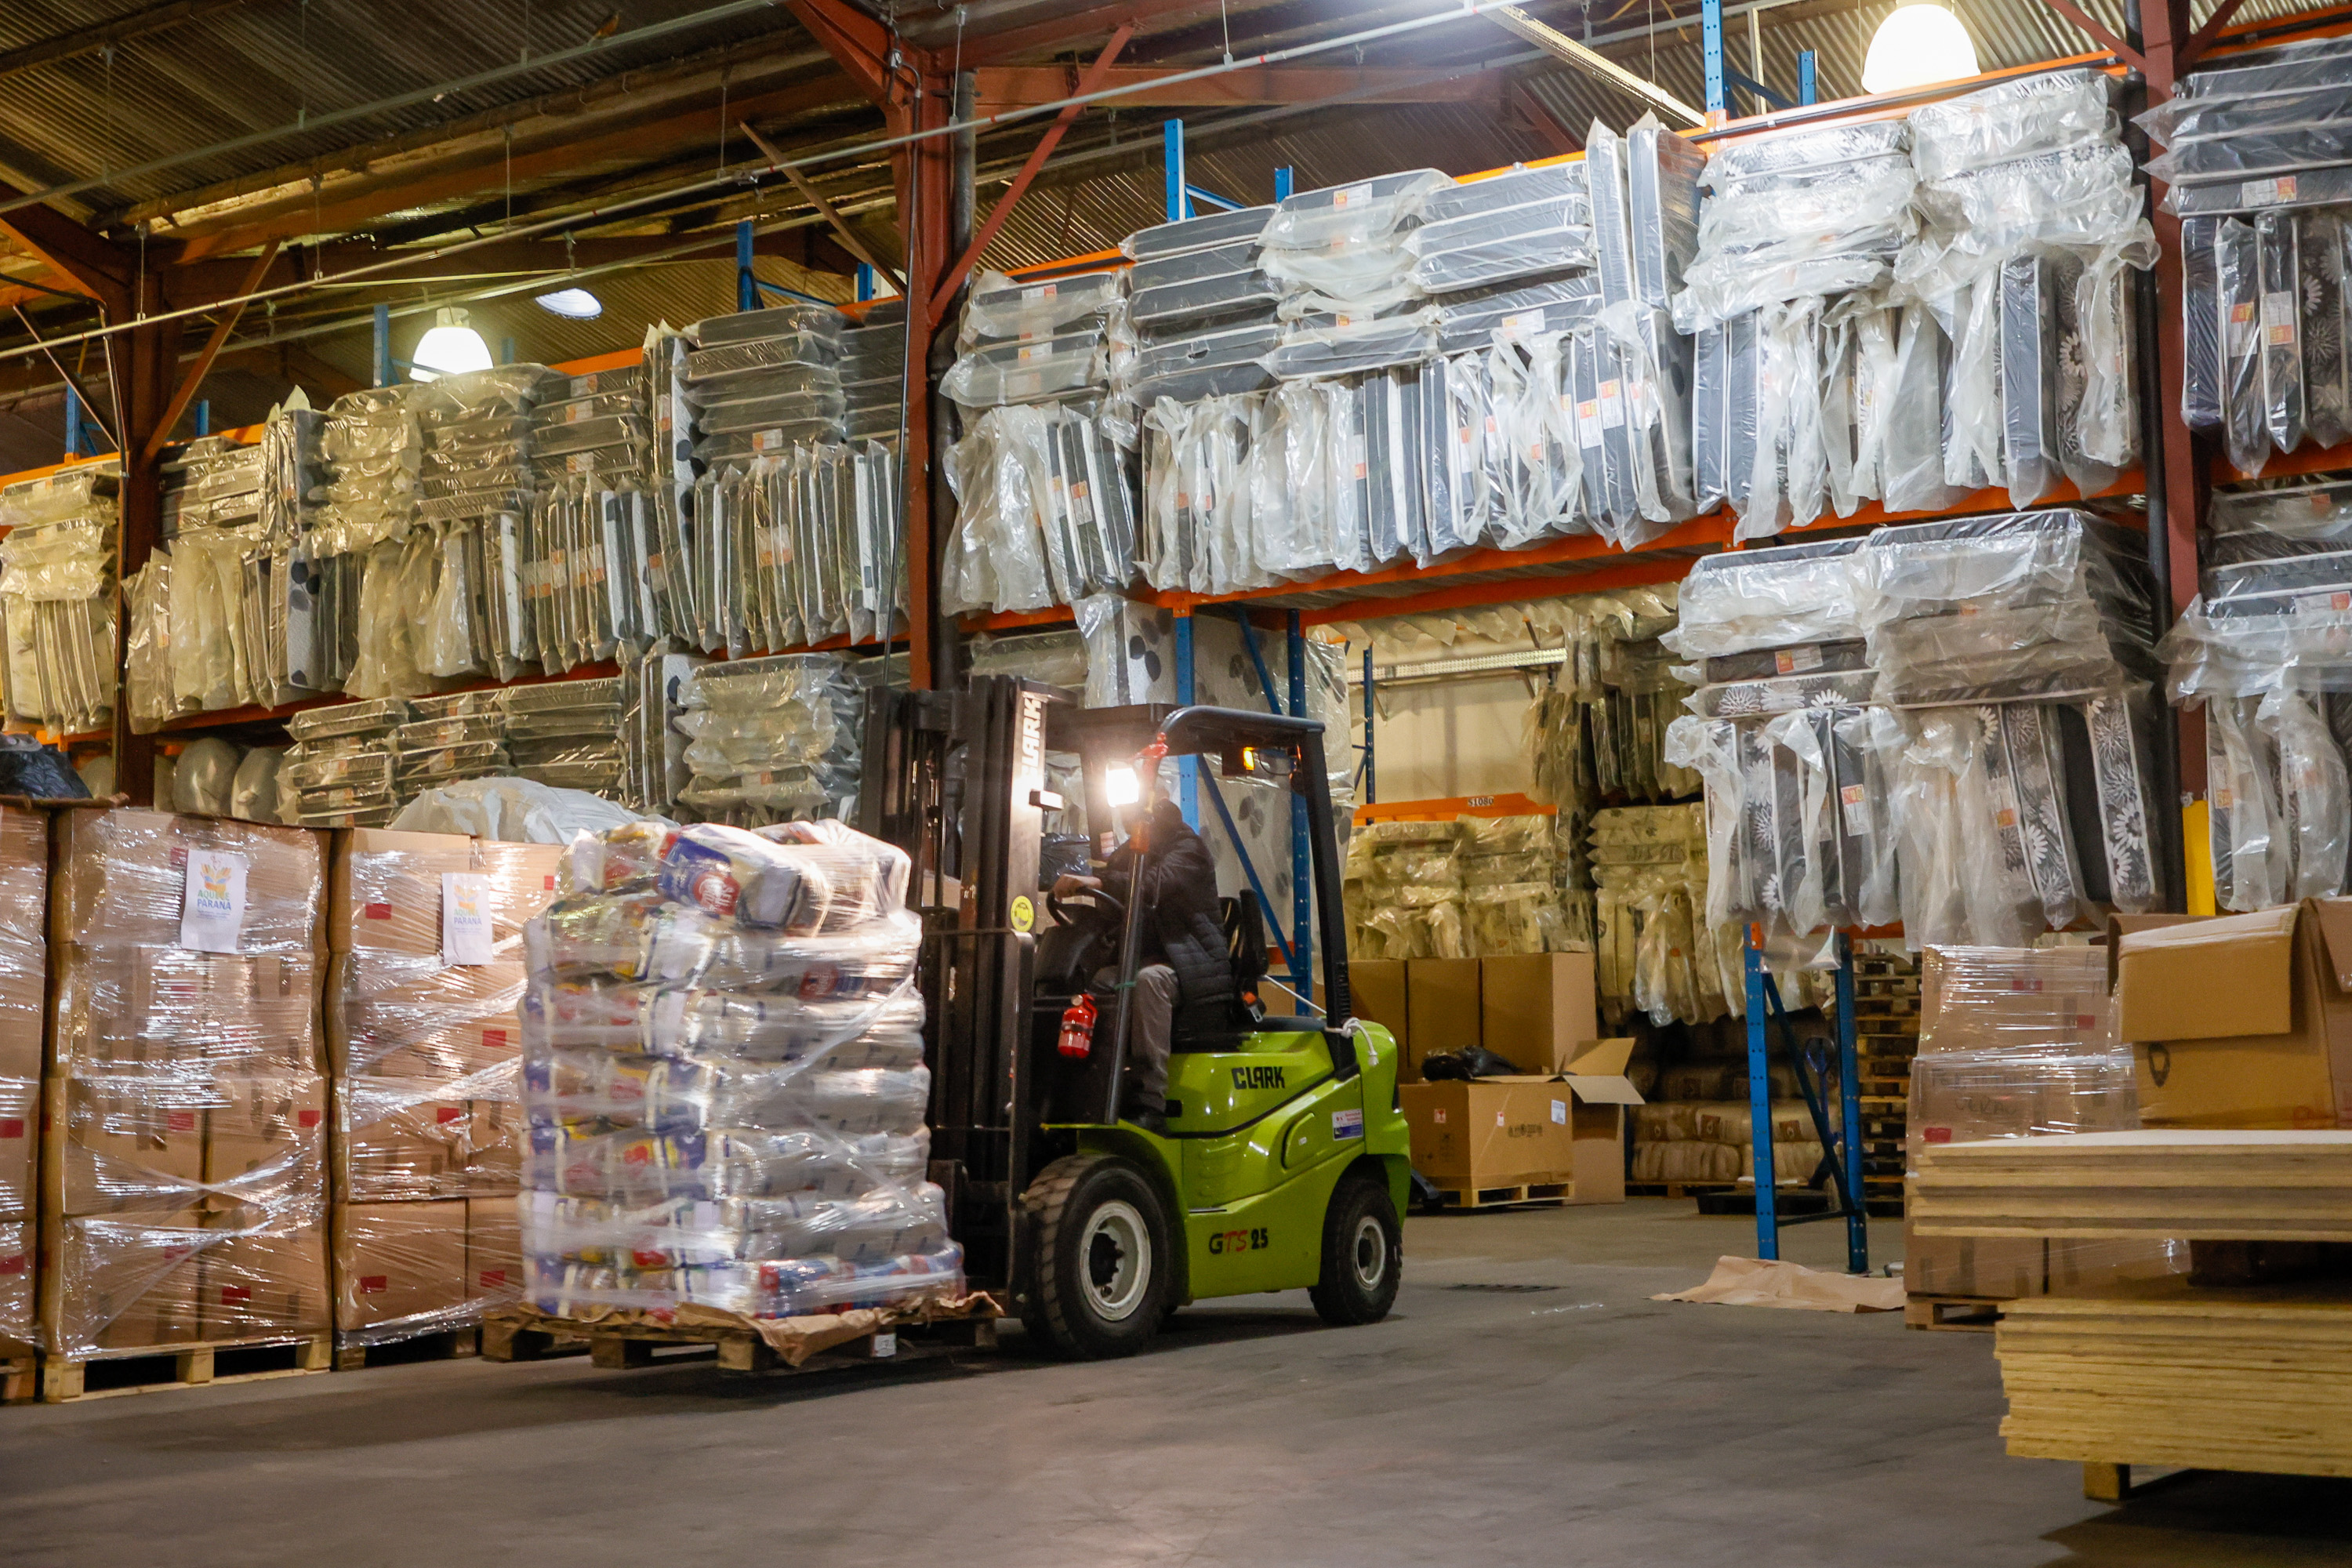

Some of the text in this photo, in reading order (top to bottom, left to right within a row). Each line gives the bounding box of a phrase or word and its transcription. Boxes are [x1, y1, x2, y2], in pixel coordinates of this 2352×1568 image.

[1231, 1066, 1285, 1090] CLARK
[1208, 1227, 1269, 1255] GTS 25
